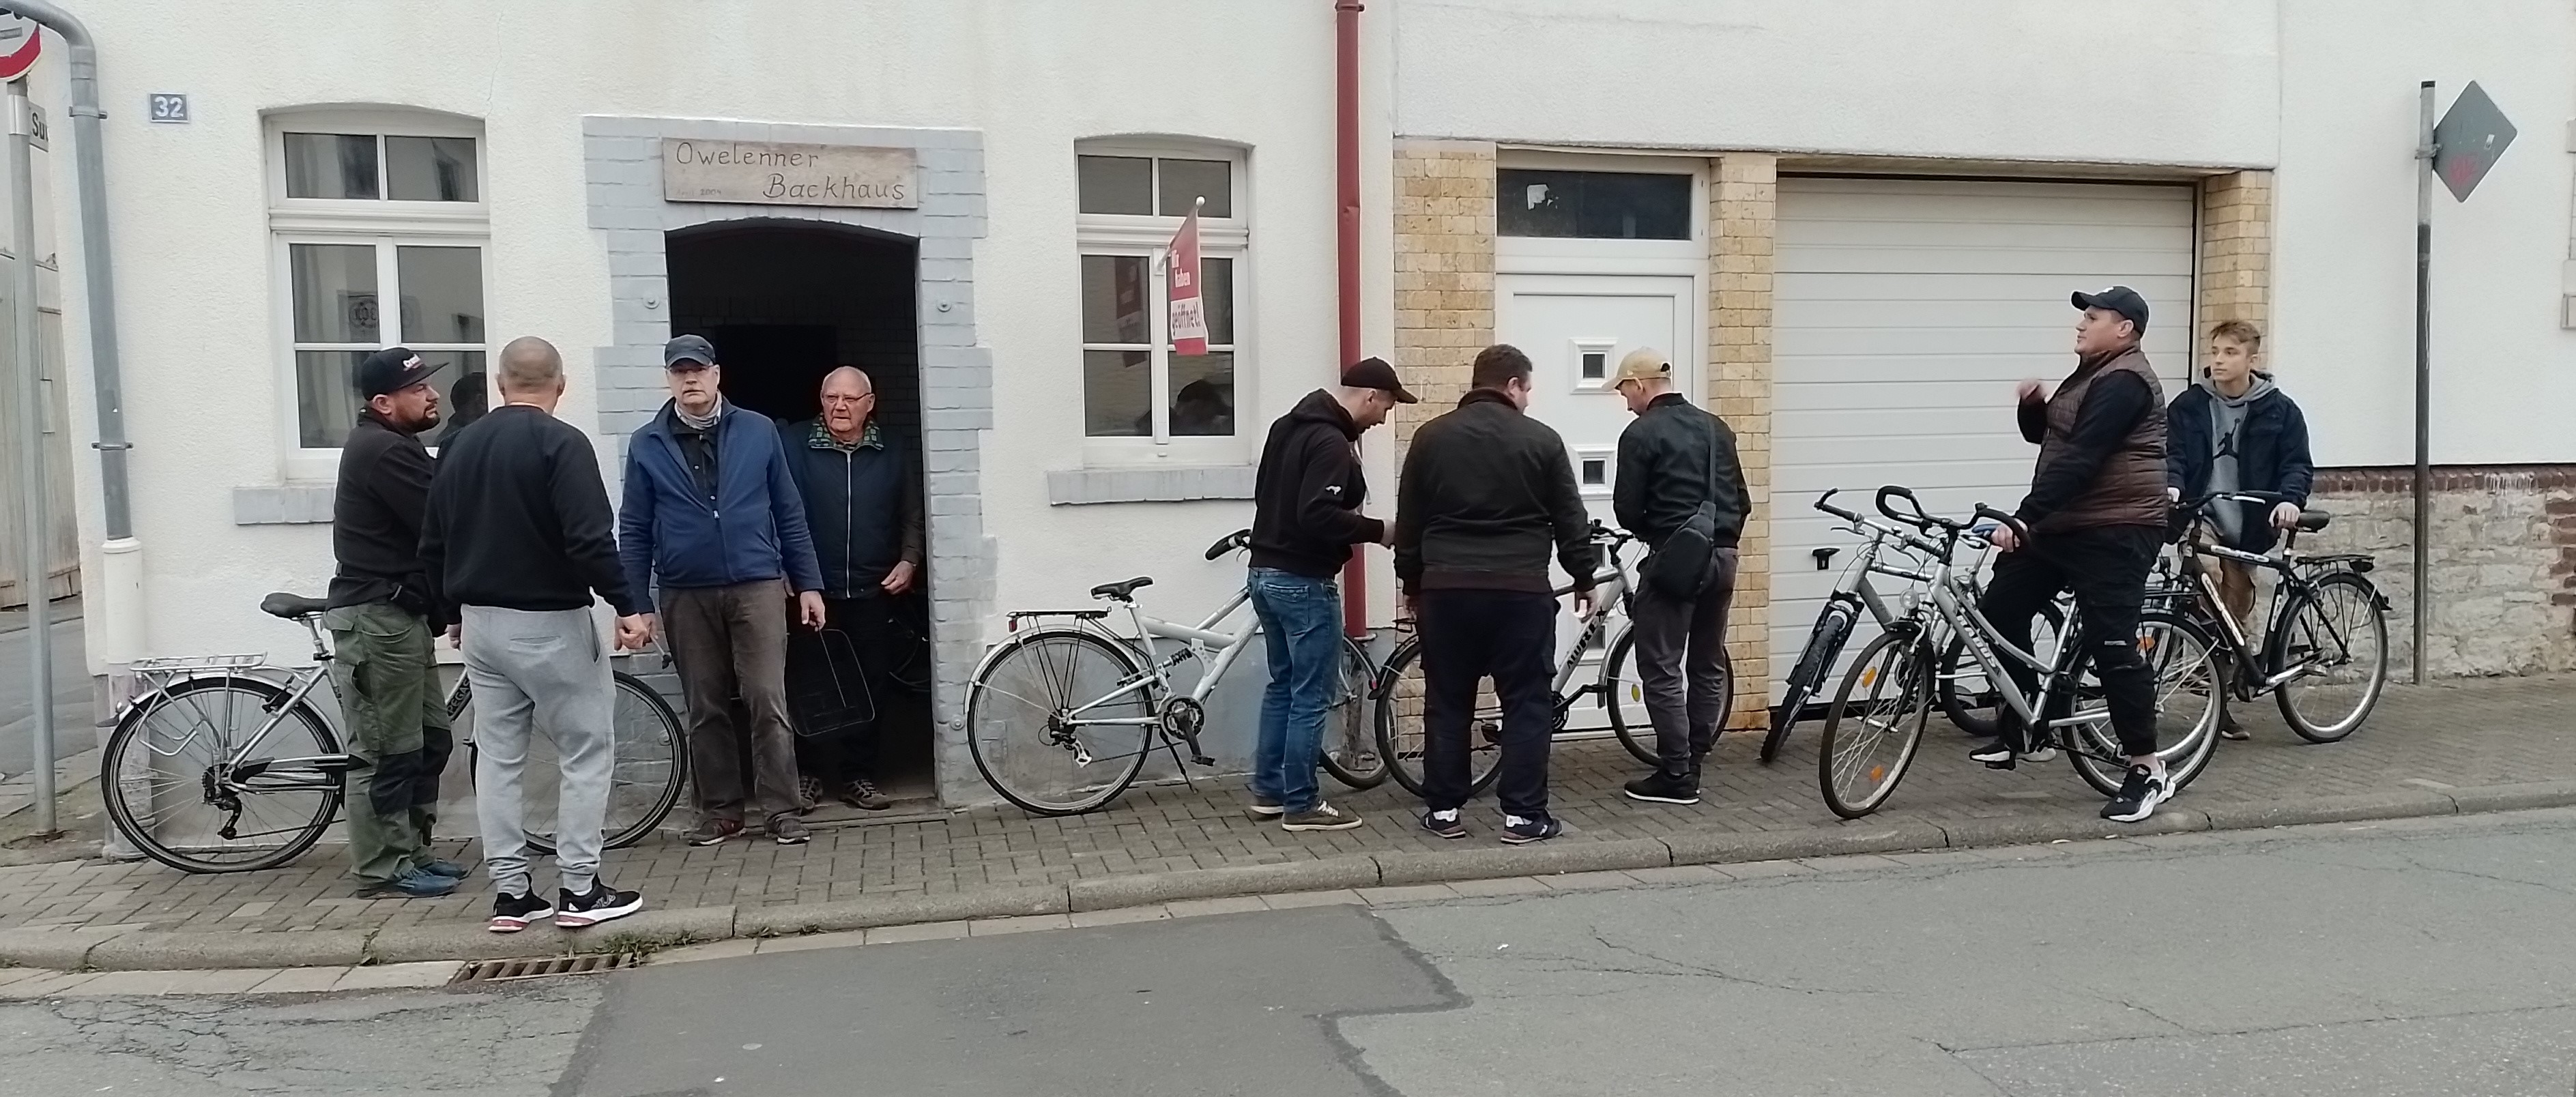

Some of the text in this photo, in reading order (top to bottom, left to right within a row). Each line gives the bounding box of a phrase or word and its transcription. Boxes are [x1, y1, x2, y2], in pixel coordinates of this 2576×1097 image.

[154, 96, 184, 117] 32
[676, 141, 819, 167] Owelenner
[762, 173, 905, 201] Backhaus
[1174, 267, 1191, 289] haben
[1172, 301, 1201, 336] geöffnet!
